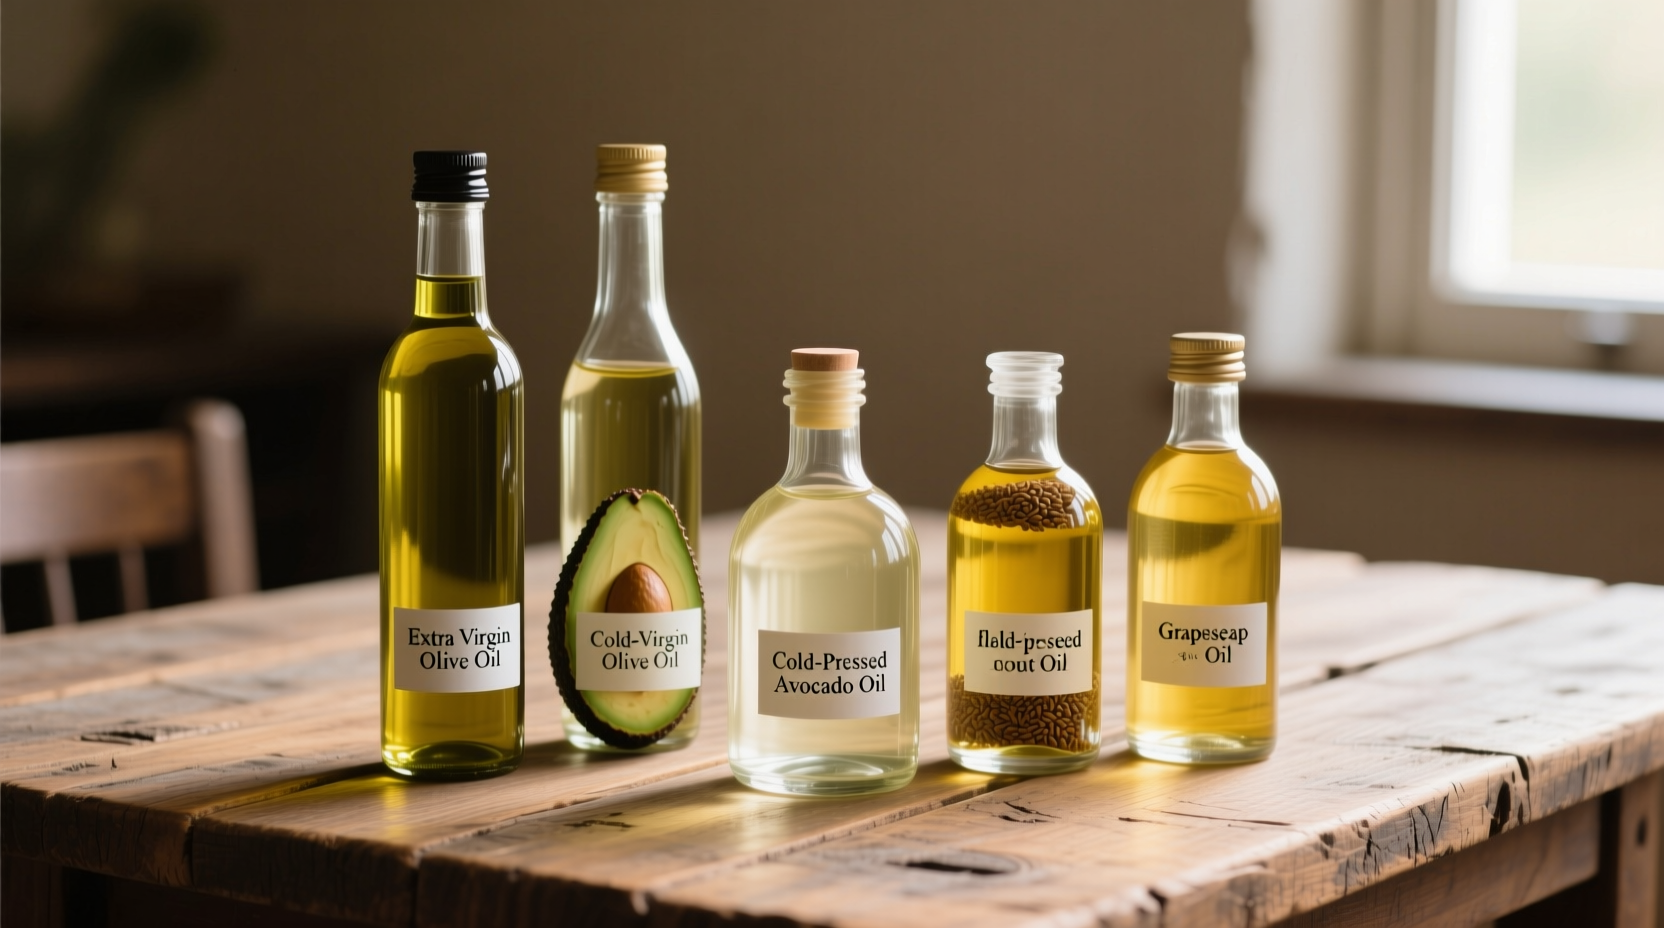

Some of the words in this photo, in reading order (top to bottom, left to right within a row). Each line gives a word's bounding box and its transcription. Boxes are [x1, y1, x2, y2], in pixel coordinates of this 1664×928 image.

[408, 628, 454, 646] Extra
[459, 626, 510, 650] Virgin
[590, 629, 688, 652] Cold-Virgin
[420, 651, 469, 669] Olive
[475, 649, 501, 668] Oil
[602, 651, 649, 669] Olive
[654, 651, 678, 668] Oil
[772, 650, 887, 670] Cold-Pressed
[1040, 653, 1067, 672] Oil
[1205, 644, 1231, 663] Oil
[774, 675, 854, 694] Avocado
[859, 673, 886, 693] Oil
